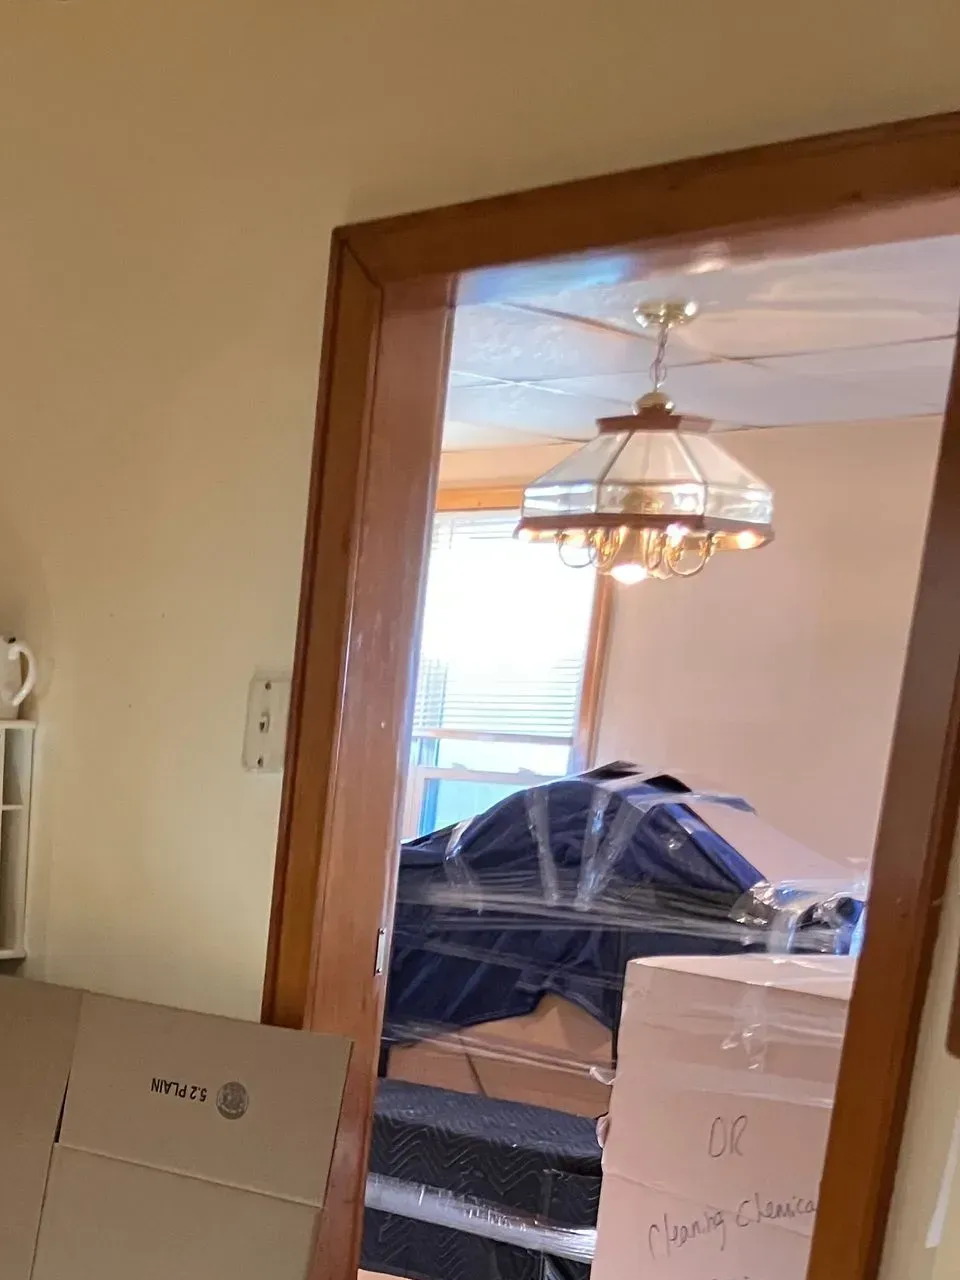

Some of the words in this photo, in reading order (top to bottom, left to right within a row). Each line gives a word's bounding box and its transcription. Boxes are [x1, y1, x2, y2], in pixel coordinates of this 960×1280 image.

[150, 1077, 188, 1099] PLAIN
[189, 1085, 208, 1102] 5.2
[707, 1114, 749, 1159] OR
